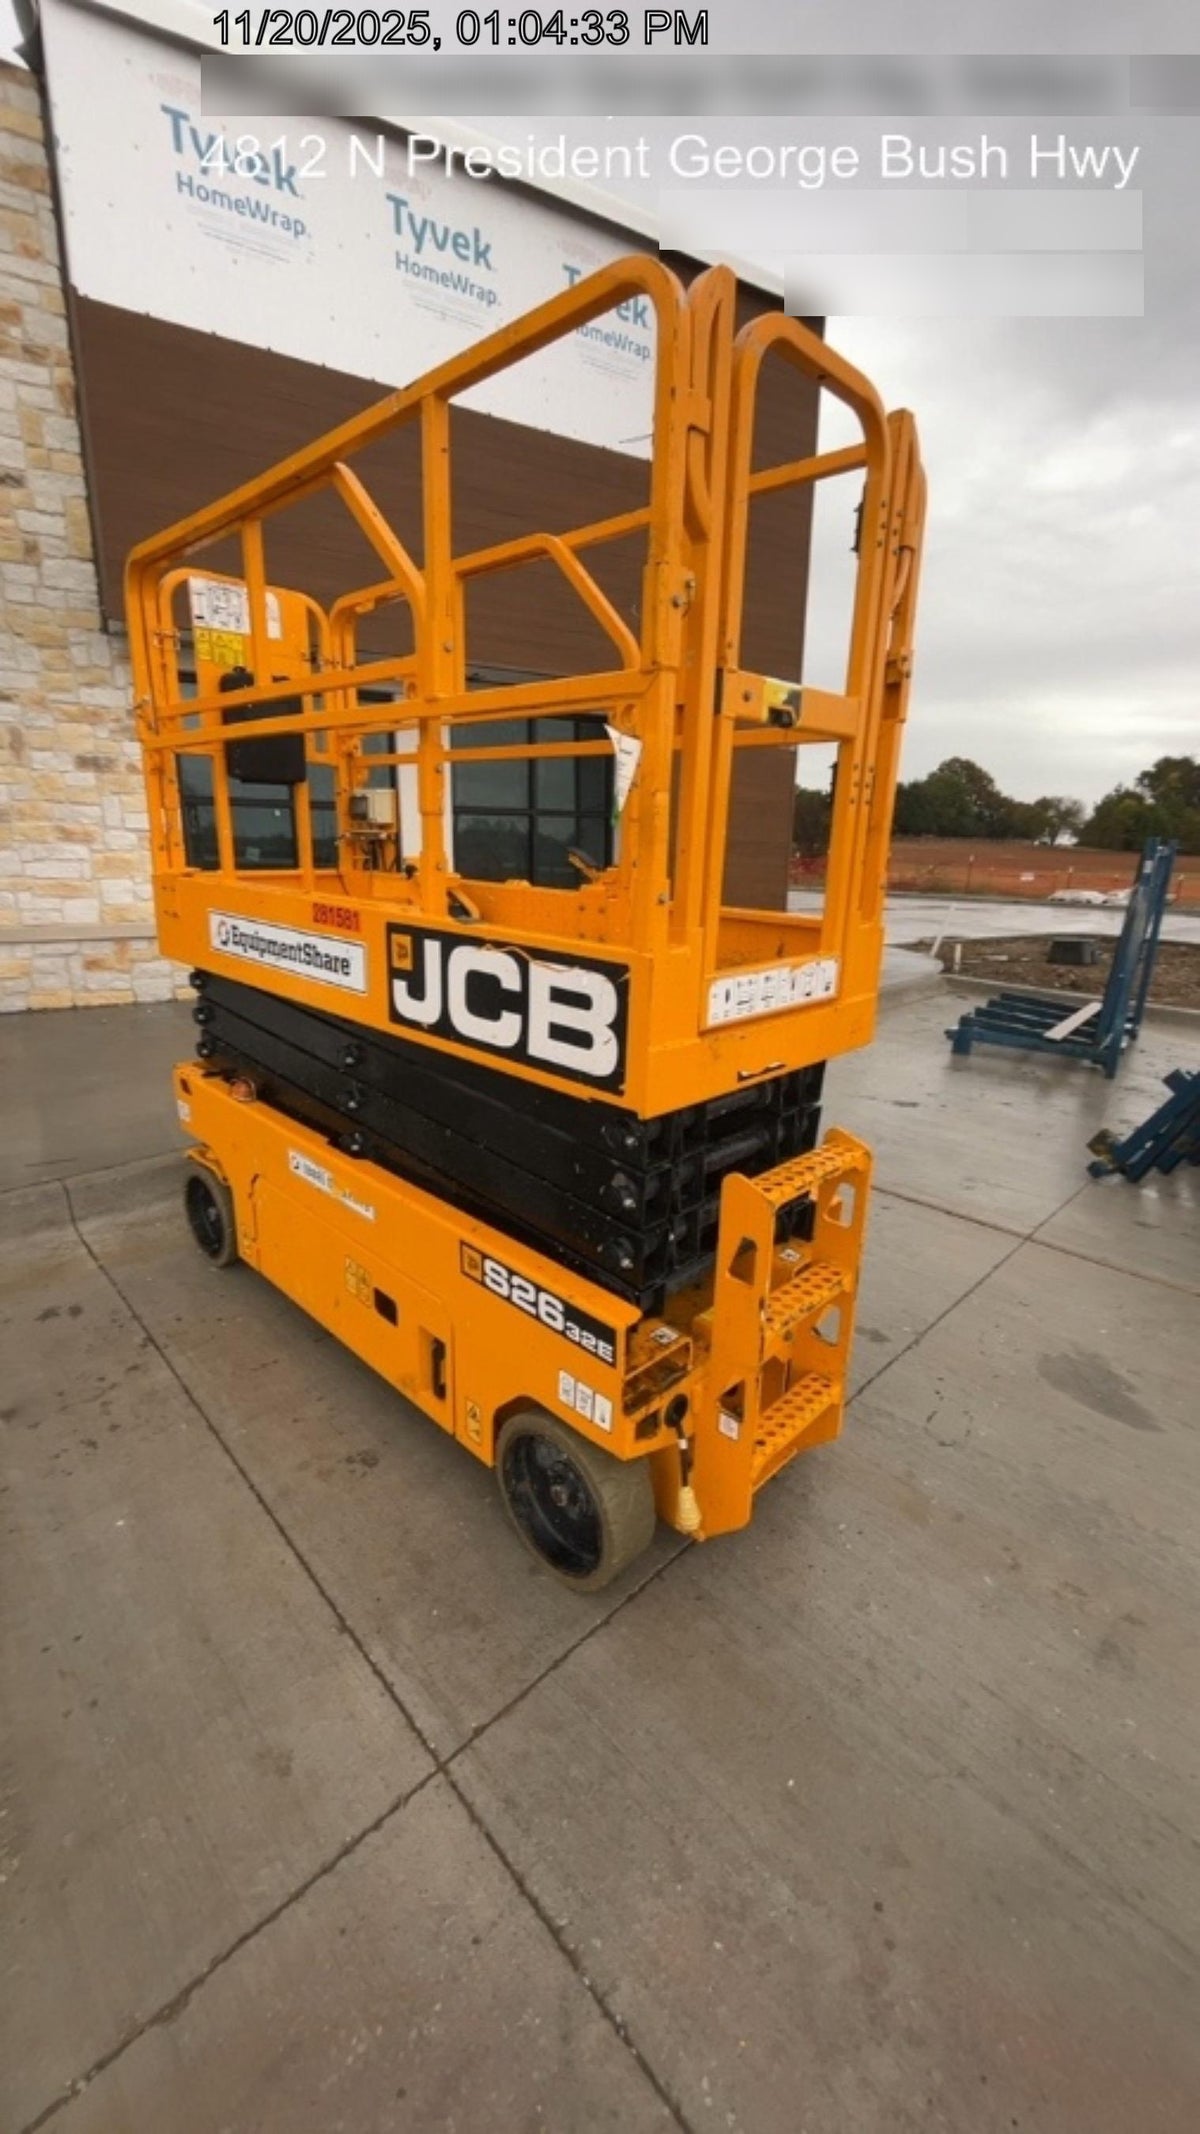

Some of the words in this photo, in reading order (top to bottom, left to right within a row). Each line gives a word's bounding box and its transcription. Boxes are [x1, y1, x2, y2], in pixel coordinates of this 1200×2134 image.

[175, 171, 306, 239] HomeWrap
[385, 192, 492, 272] Tyvek
[395, 250, 498, 308] HomeWrap
[562, 264, 649, 329] Tek
[575, 322, 651, 361] omeWrap
[231, 924, 351, 976] EquipmentShare
[392, 938, 618, 1077] JCB
